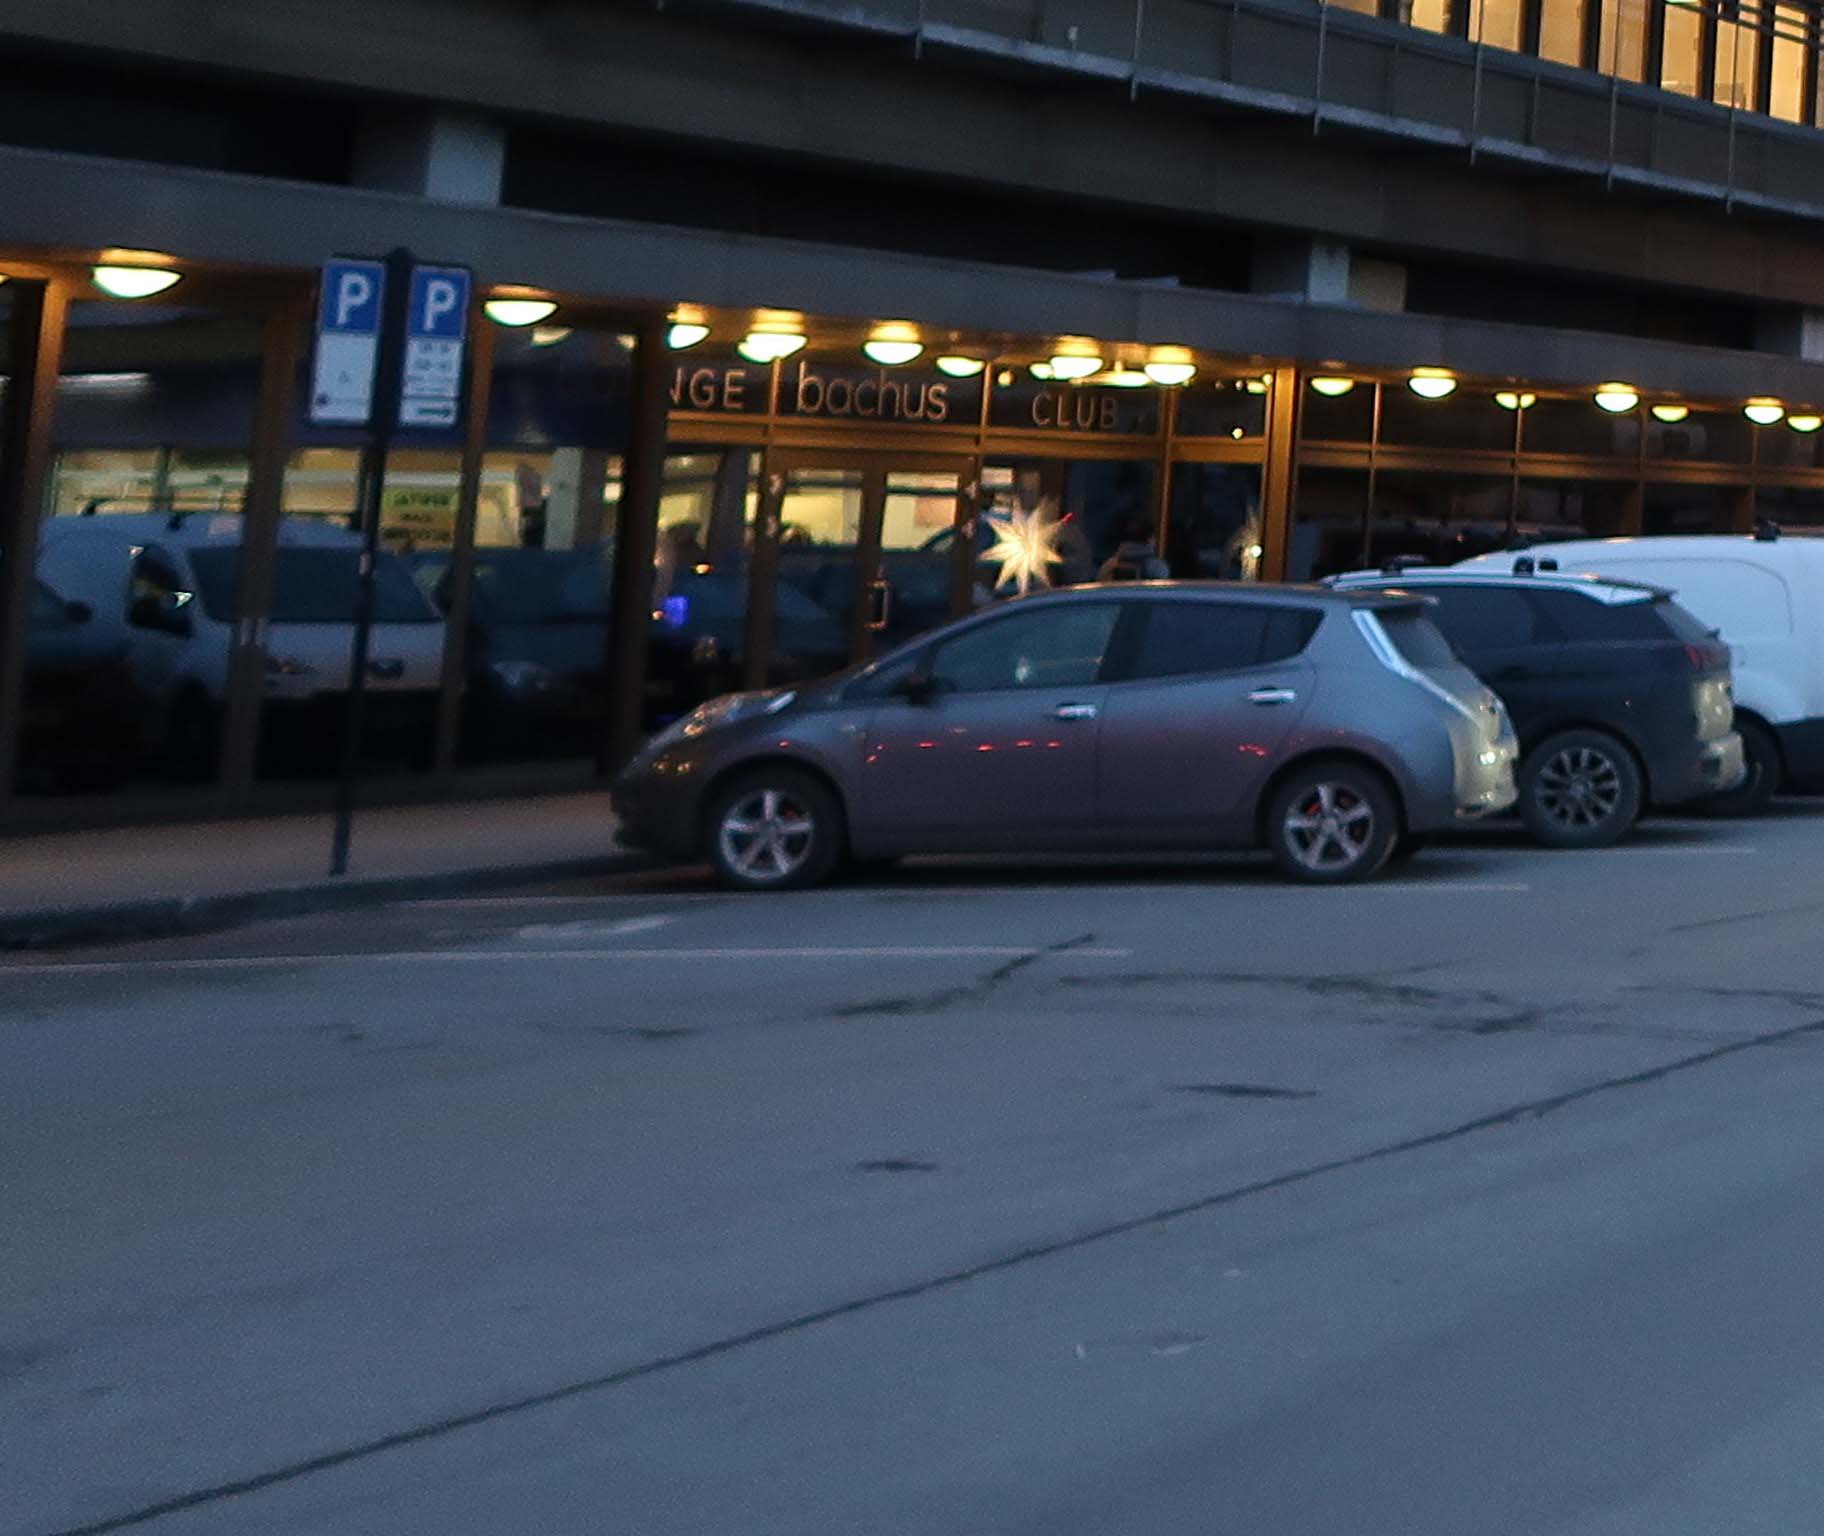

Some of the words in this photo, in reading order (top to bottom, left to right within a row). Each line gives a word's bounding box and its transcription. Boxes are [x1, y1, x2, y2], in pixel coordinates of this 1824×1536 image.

[336, 272, 370, 326] P
[423, 280, 457, 332] P
[796, 359, 952, 422] bachus
[1031, 391, 1118, 428] CLUB
